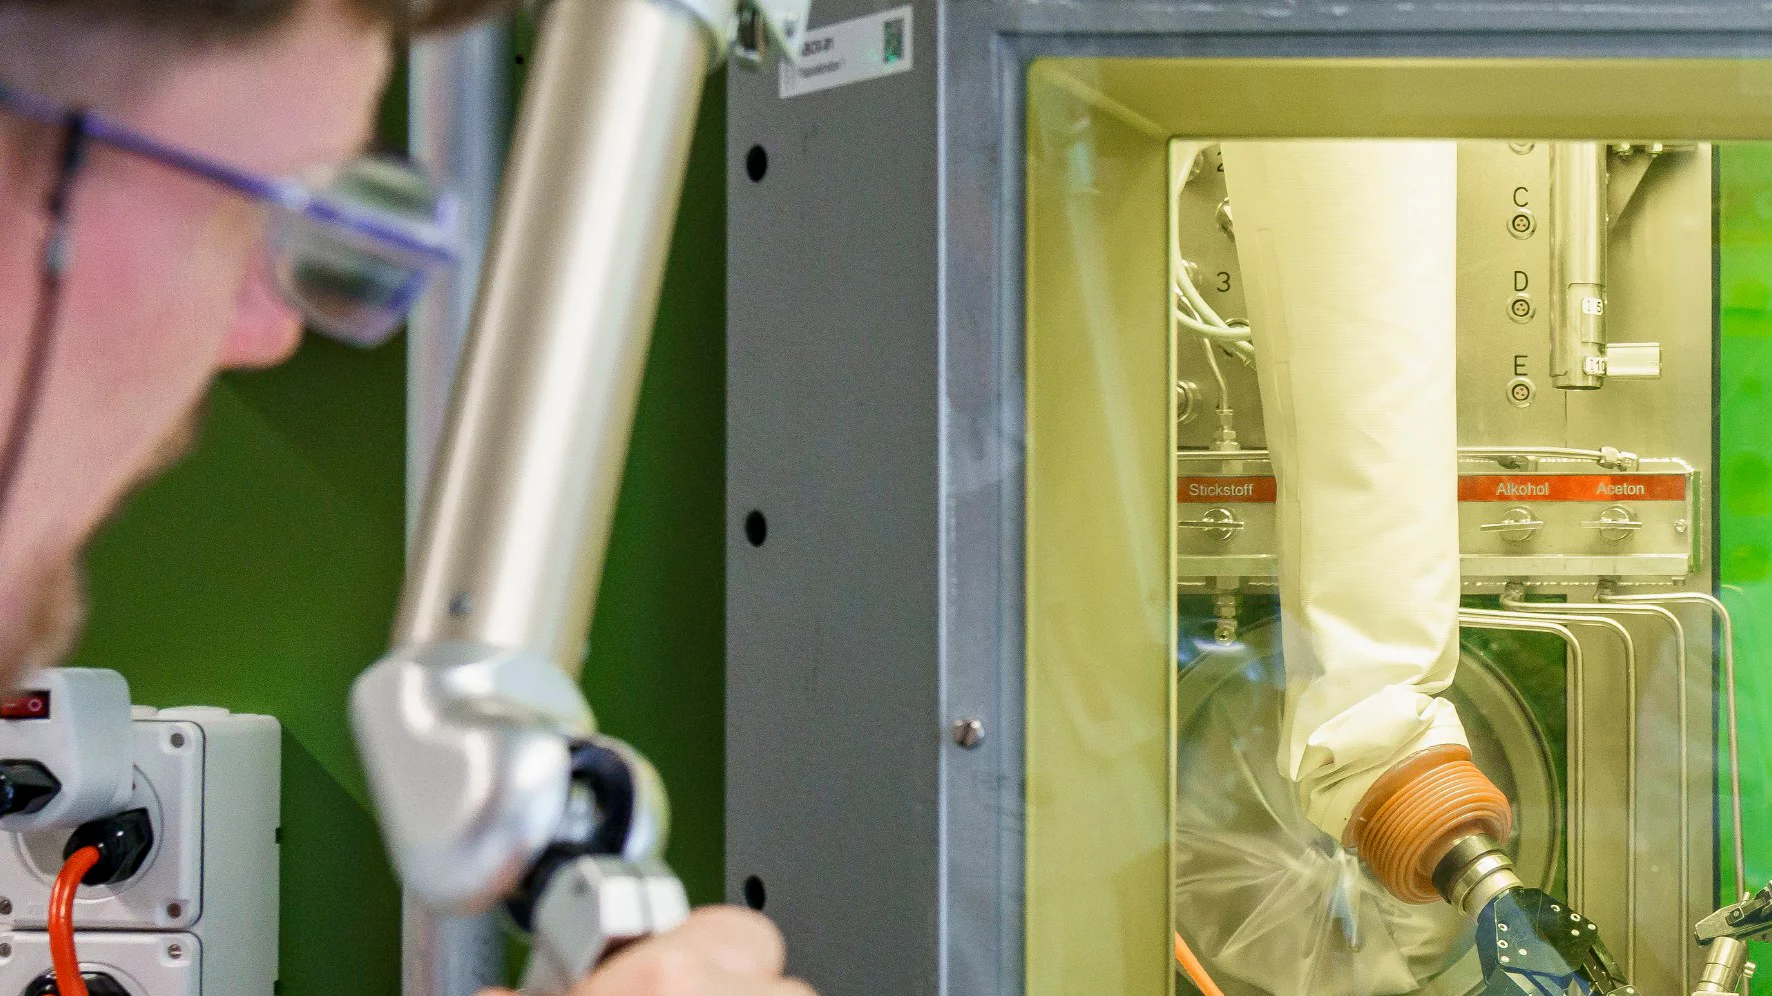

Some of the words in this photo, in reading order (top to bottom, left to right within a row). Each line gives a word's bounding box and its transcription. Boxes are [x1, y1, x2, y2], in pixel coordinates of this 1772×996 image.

[1513, 186, 1528, 207] C
[1216, 271, 1231, 292] 3
[1513, 270, 1529, 291] D
[1596, 301, 1602, 313] 5
[1513, 354, 1529, 376] E
[1188, 482, 1254, 497] Stickstoff
[1495, 481, 1550, 496] Alkohol
[1596, 481, 1646, 496] Aceton
